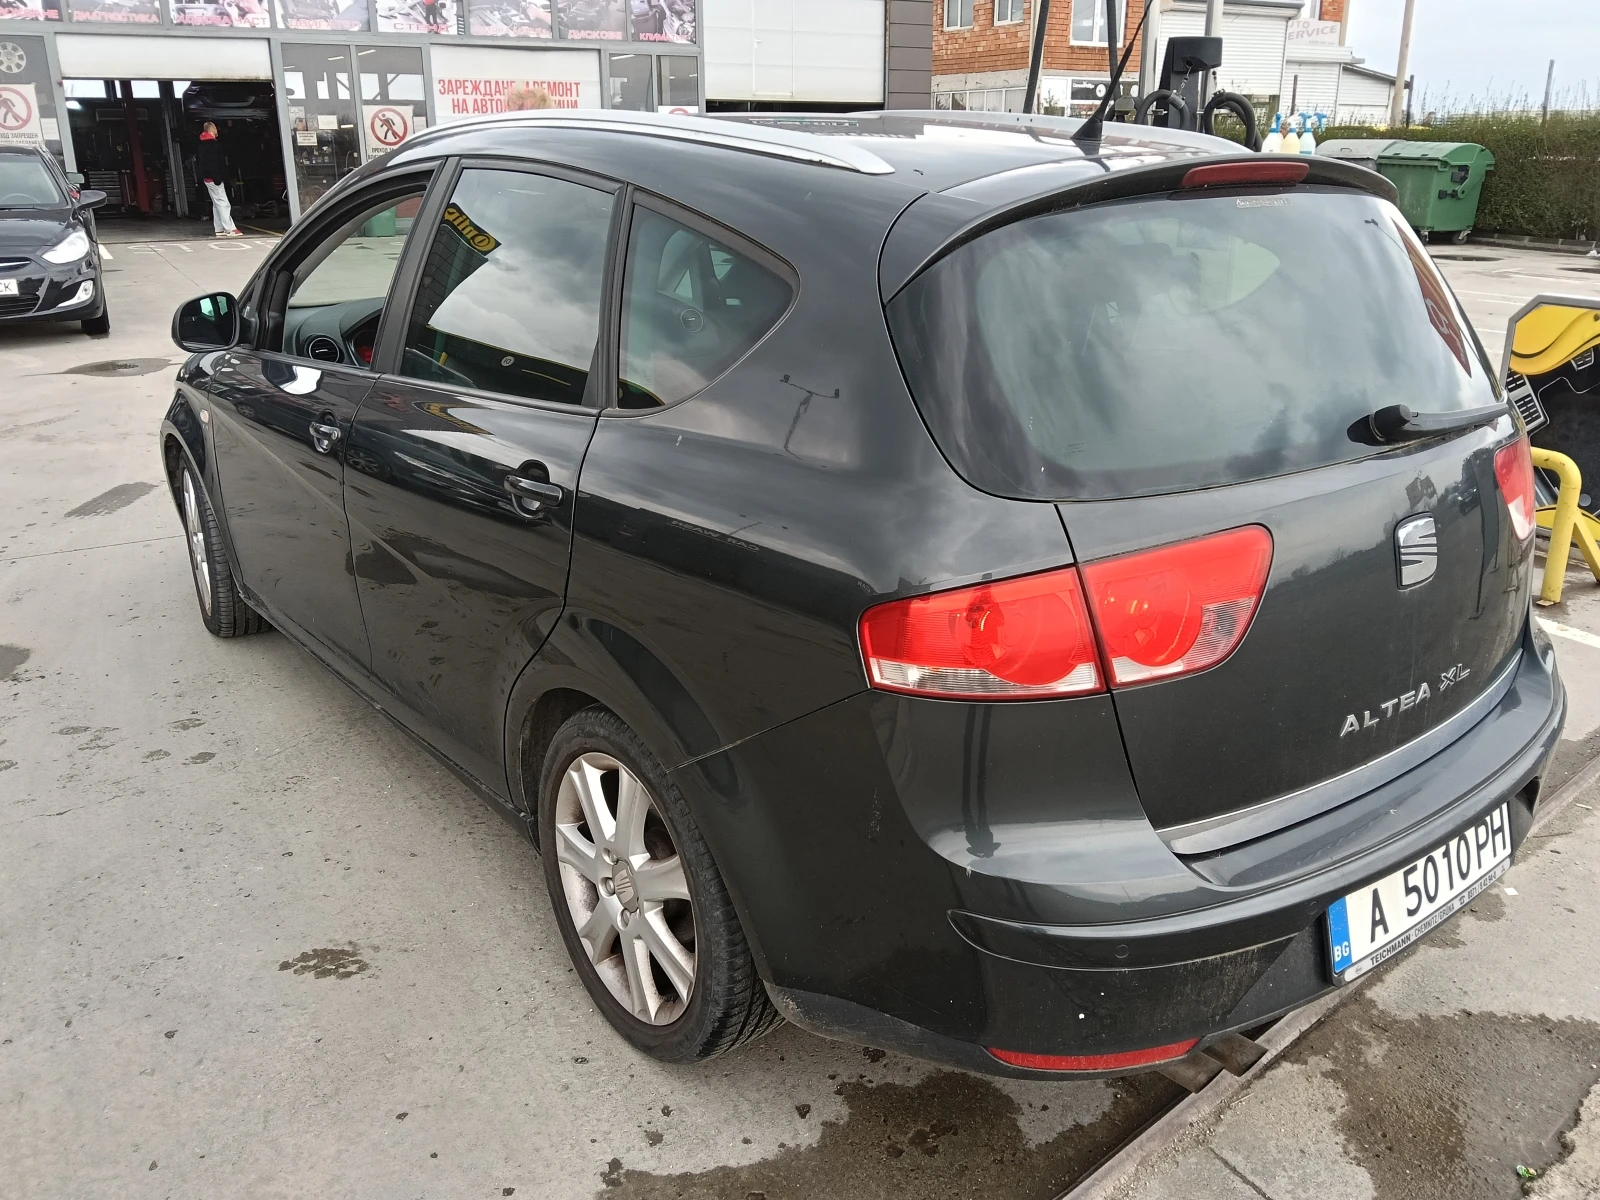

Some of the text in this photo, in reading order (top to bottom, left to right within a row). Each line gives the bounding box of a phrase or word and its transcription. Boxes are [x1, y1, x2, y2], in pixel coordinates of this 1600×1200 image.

[73, 10, 160, 23] ДИАГНОСТИКА
[235, 17, 267, 26] ЧАСТ
[568, 30, 623, 39] ДИСКОВЕ
[1288, 25, 1338, 40] ERVICE
[452, 98, 470, 113] НА
[1340, 663, 1471, 737] ALTEA XL
[1370, 808, 1507, 944] A 5010 PH
[1334, 941, 1350, 962] BG
[1370, 933, 1411, 966] TEICHMANN
